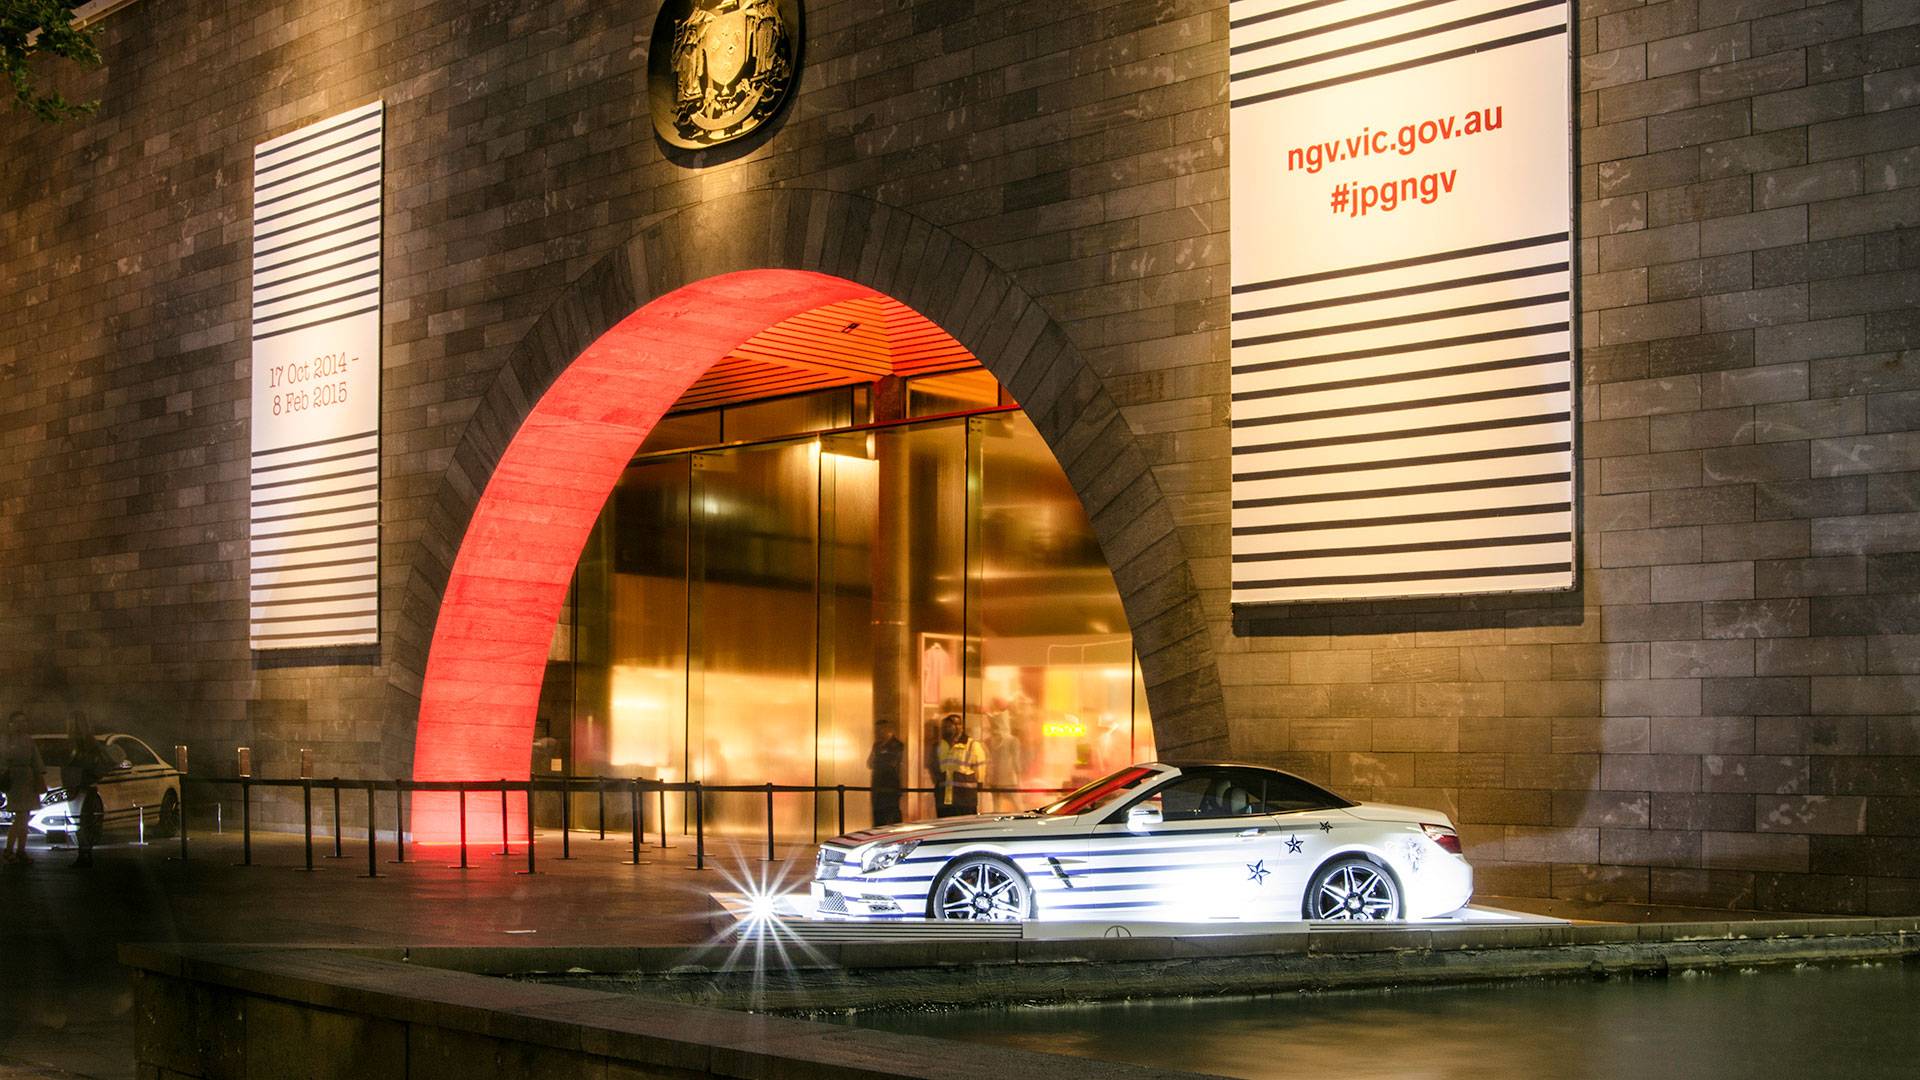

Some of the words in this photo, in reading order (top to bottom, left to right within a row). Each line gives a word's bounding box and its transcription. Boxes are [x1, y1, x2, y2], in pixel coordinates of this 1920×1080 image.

[1288, 105, 1503, 174] ngv.vic.gov.au
[1330, 169, 1457, 218] #jpgngv
[269, 365, 284, 389] 17
[288, 362, 310, 385] Oct
[313, 351, 348, 380] 2014
[272, 394, 282, 416] 8
[285, 390, 309, 413] Feb
[312, 380, 348, 408] 2015
